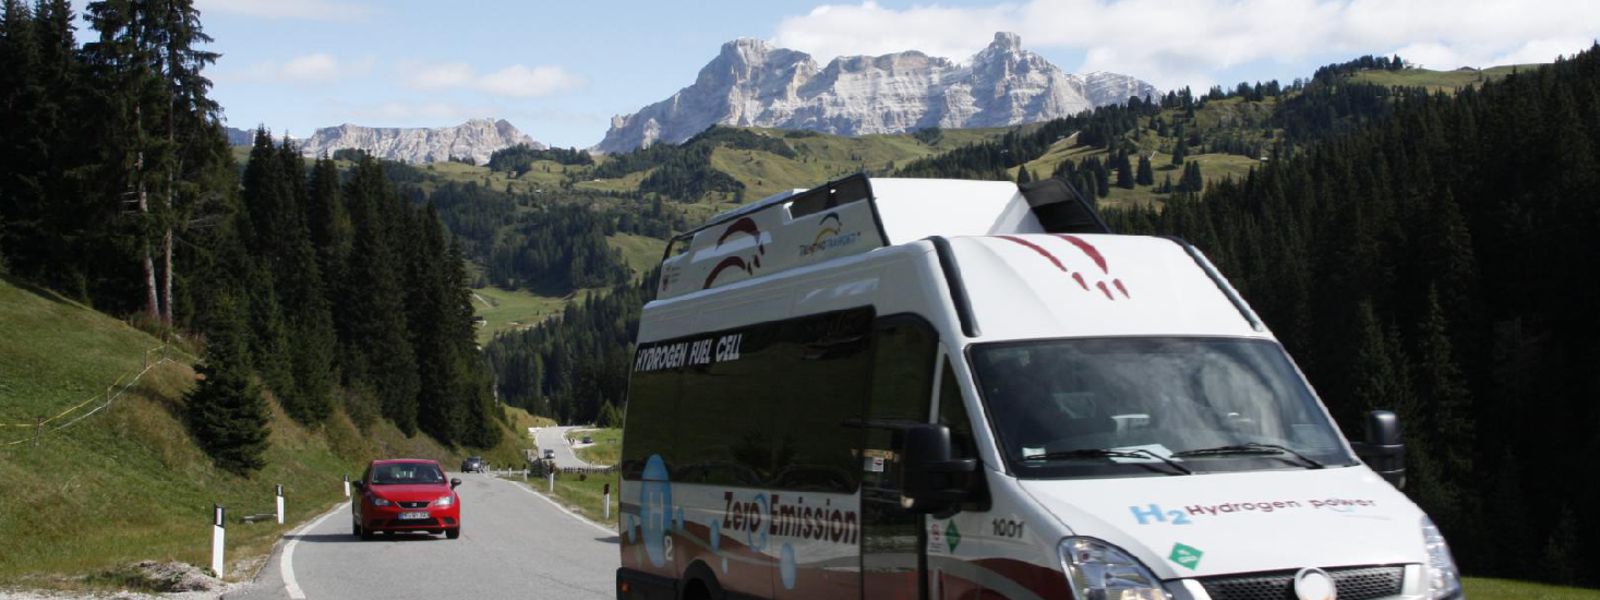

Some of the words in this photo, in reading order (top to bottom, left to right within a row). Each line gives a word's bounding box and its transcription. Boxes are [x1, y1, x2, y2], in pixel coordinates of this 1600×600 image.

[635, 342, 688, 372] HYDROGEN
[688, 338, 713, 366] FUEL
[715, 333, 742, 362] CELL
[722, 491, 762, 532] Zero
[768, 494, 858, 545] Emission
[1185, 499, 1302, 516] Hydrogen
[1308, 497, 1377, 510] power
[992, 518, 1025, 539] 1001
